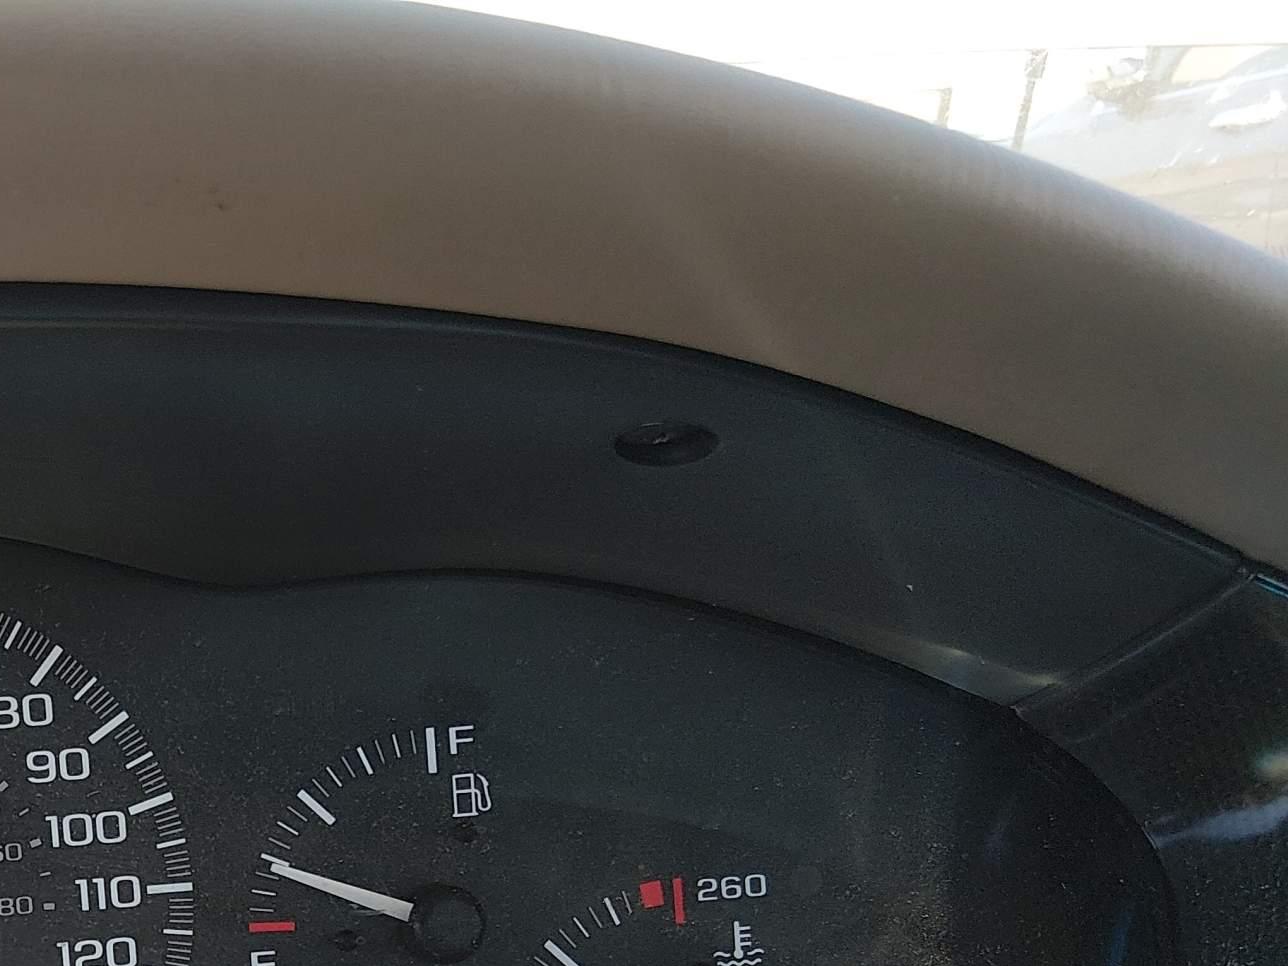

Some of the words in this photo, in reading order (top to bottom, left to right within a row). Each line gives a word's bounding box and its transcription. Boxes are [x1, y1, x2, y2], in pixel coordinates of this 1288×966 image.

[449, 726, 473, 754] F
[27, 748, 89, 783] 90
[45, 811, 127, 847] 100
[75, 876, 141, 911] 110
[698, 875, 766, 901] 260
